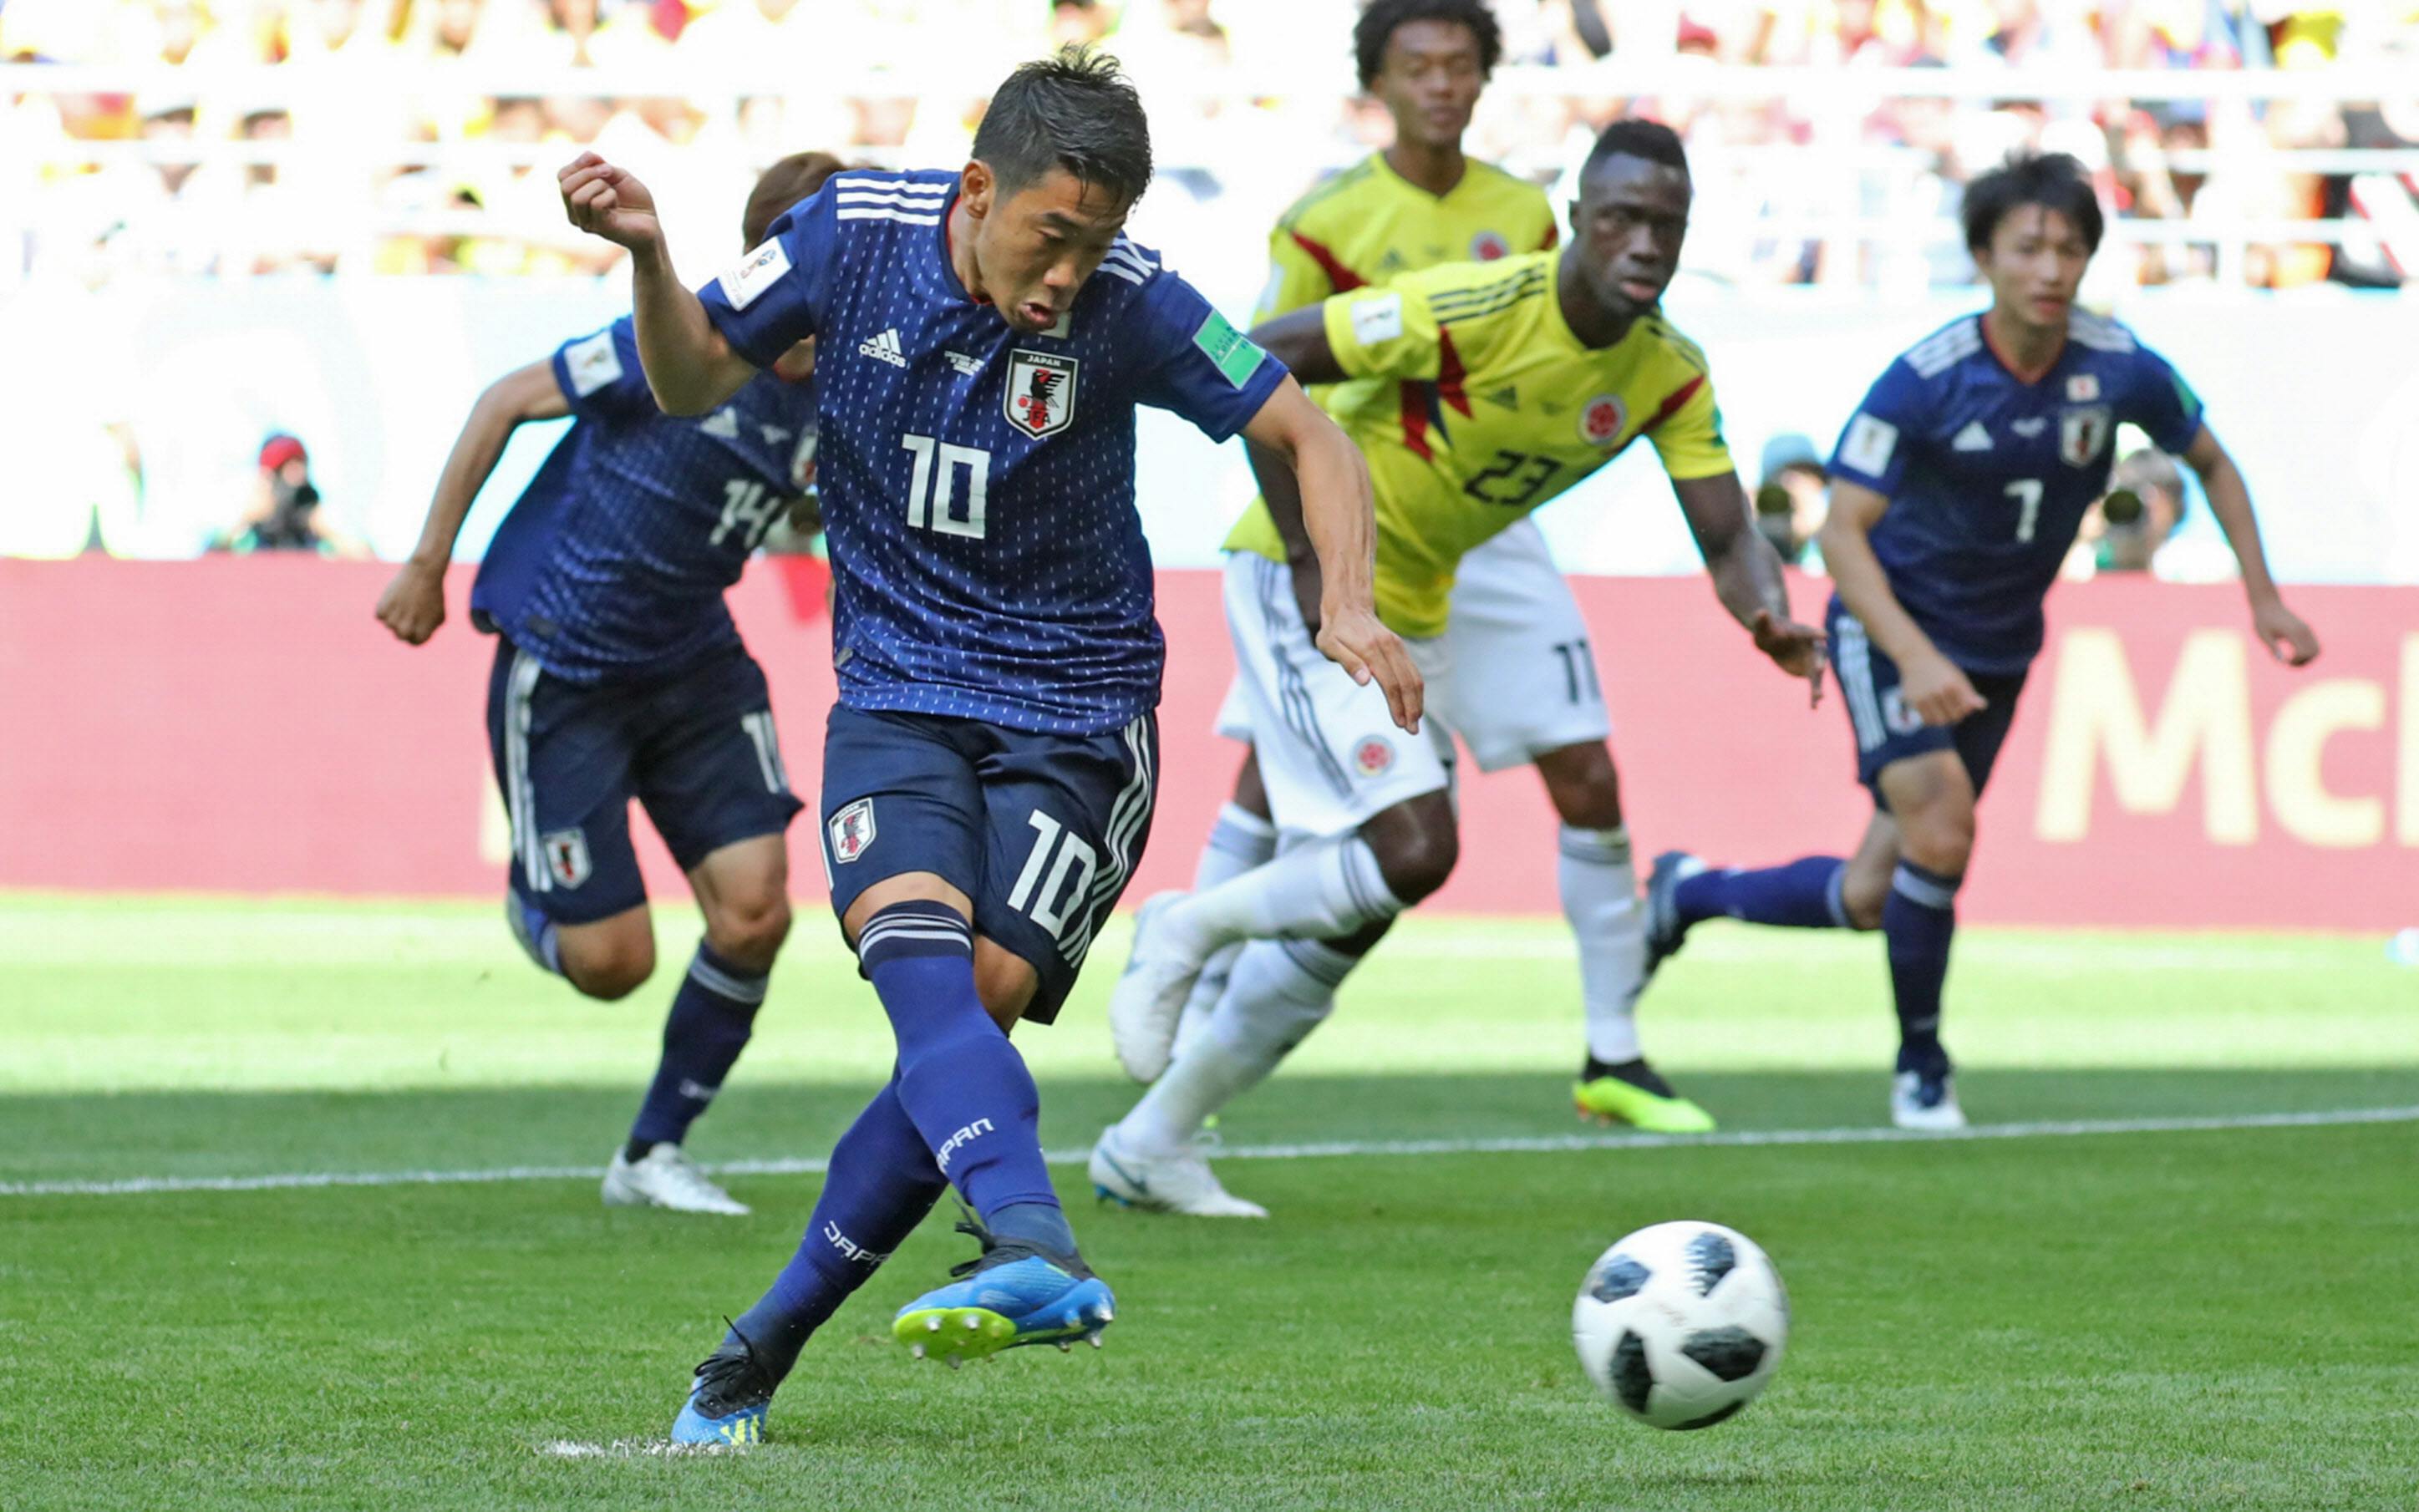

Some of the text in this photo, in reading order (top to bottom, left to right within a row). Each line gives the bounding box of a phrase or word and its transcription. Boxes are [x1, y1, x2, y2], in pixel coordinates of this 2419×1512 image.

[859, 343, 906, 368] adidas
[1027, 354, 1061, 367] JAPAN
[902, 434, 990, 540] 10
[1462, 449, 1564, 506] 23
[709, 479, 781, 550] 14
[2004, 478, 2044, 543] 7
[1551, 640, 1601, 705] 11
[1007, 809, 1096, 941] 10
[937, 1118, 994, 1175] APAN
